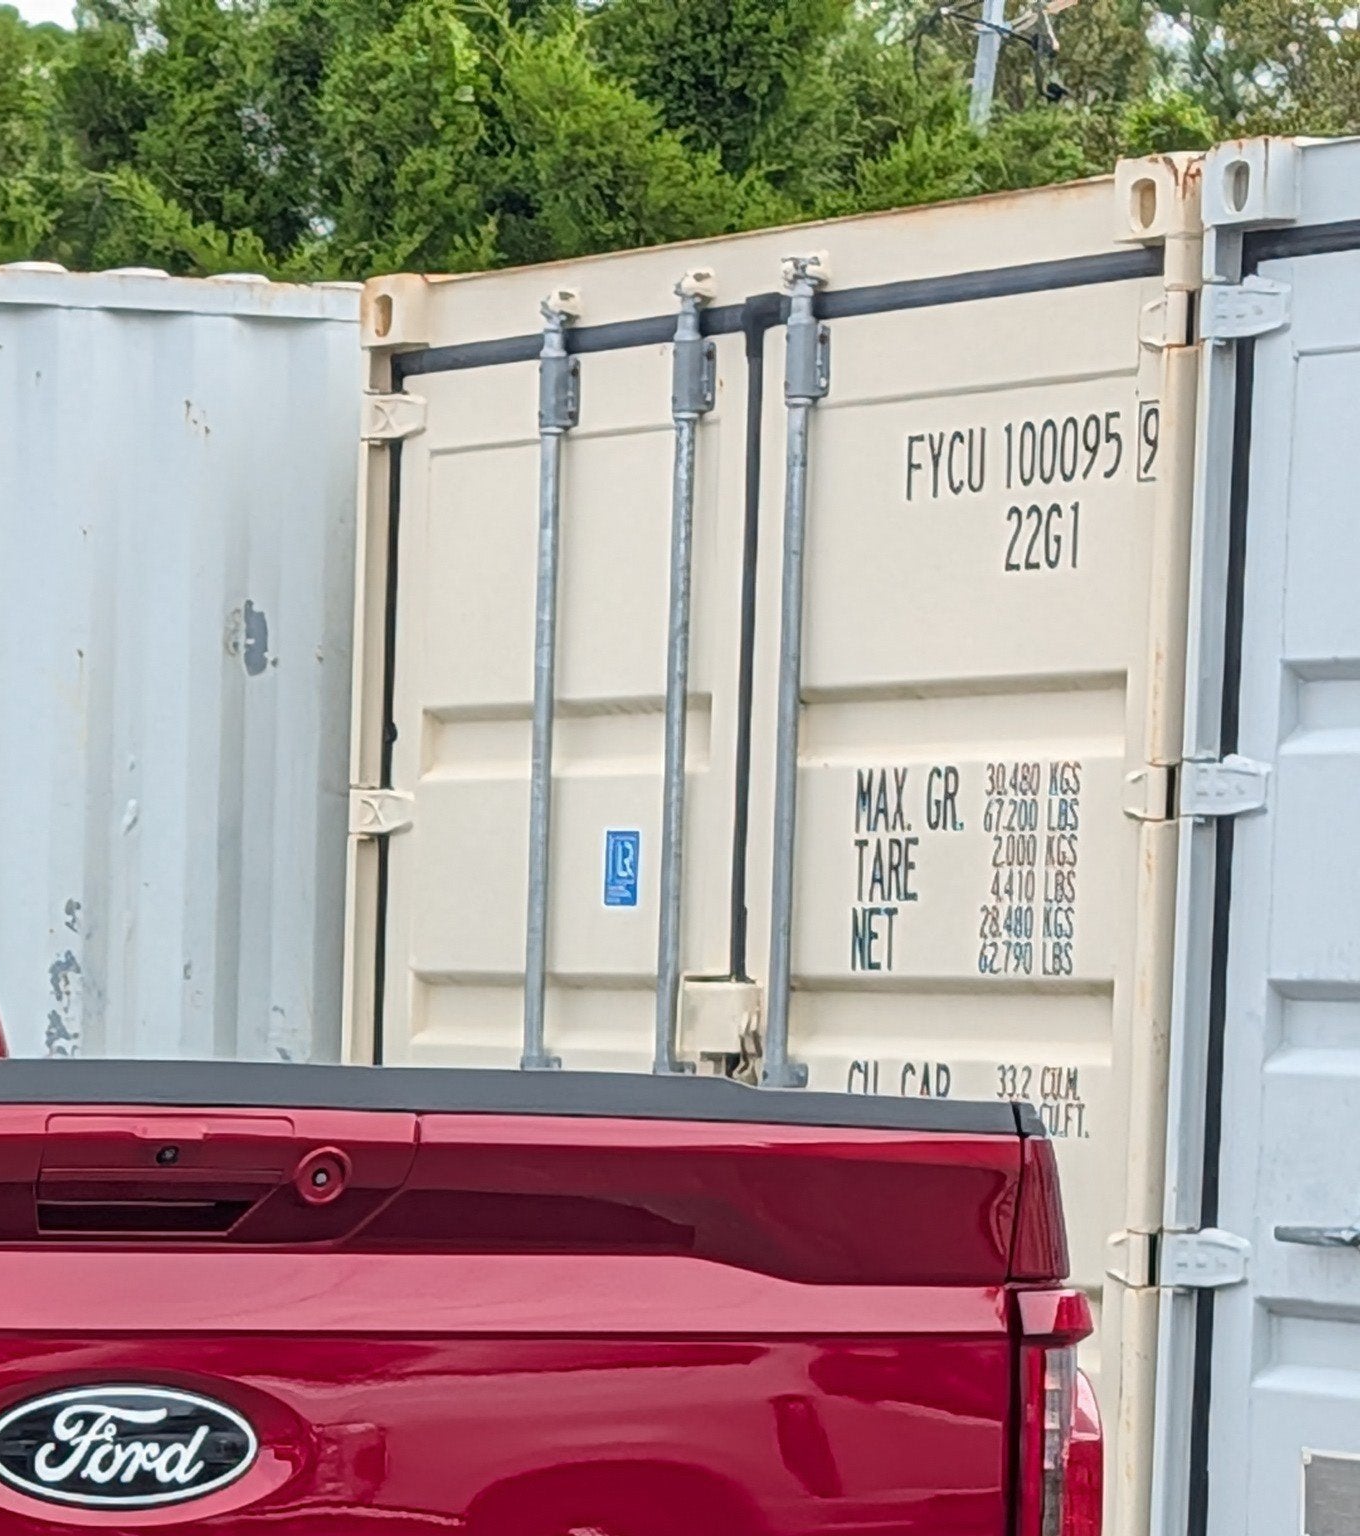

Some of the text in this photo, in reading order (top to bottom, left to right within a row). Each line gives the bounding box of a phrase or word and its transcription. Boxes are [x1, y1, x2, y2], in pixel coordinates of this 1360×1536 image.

[905, 406, 1161, 501] FYCU 100095 9
[1004, 500, 1081, 572] 22G1
[854, 767, 912, 834] MAX.
[926, 765, 965, 832] GR.
[1048, 761, 1082, 796] KGS
[1047, 798, 1079, 832] LBS
[854, 836, 920, 902] TARE
[1044, 833, 1078, 868] KGS
[1043, 869, 1076, 904] LBS
[851, 906, 899, 972] NET
[1042, 905, 1075, 939] KGS
[1042, 940, 1073, 976] LBS
[34, 1403, 210, 1484] Ford
